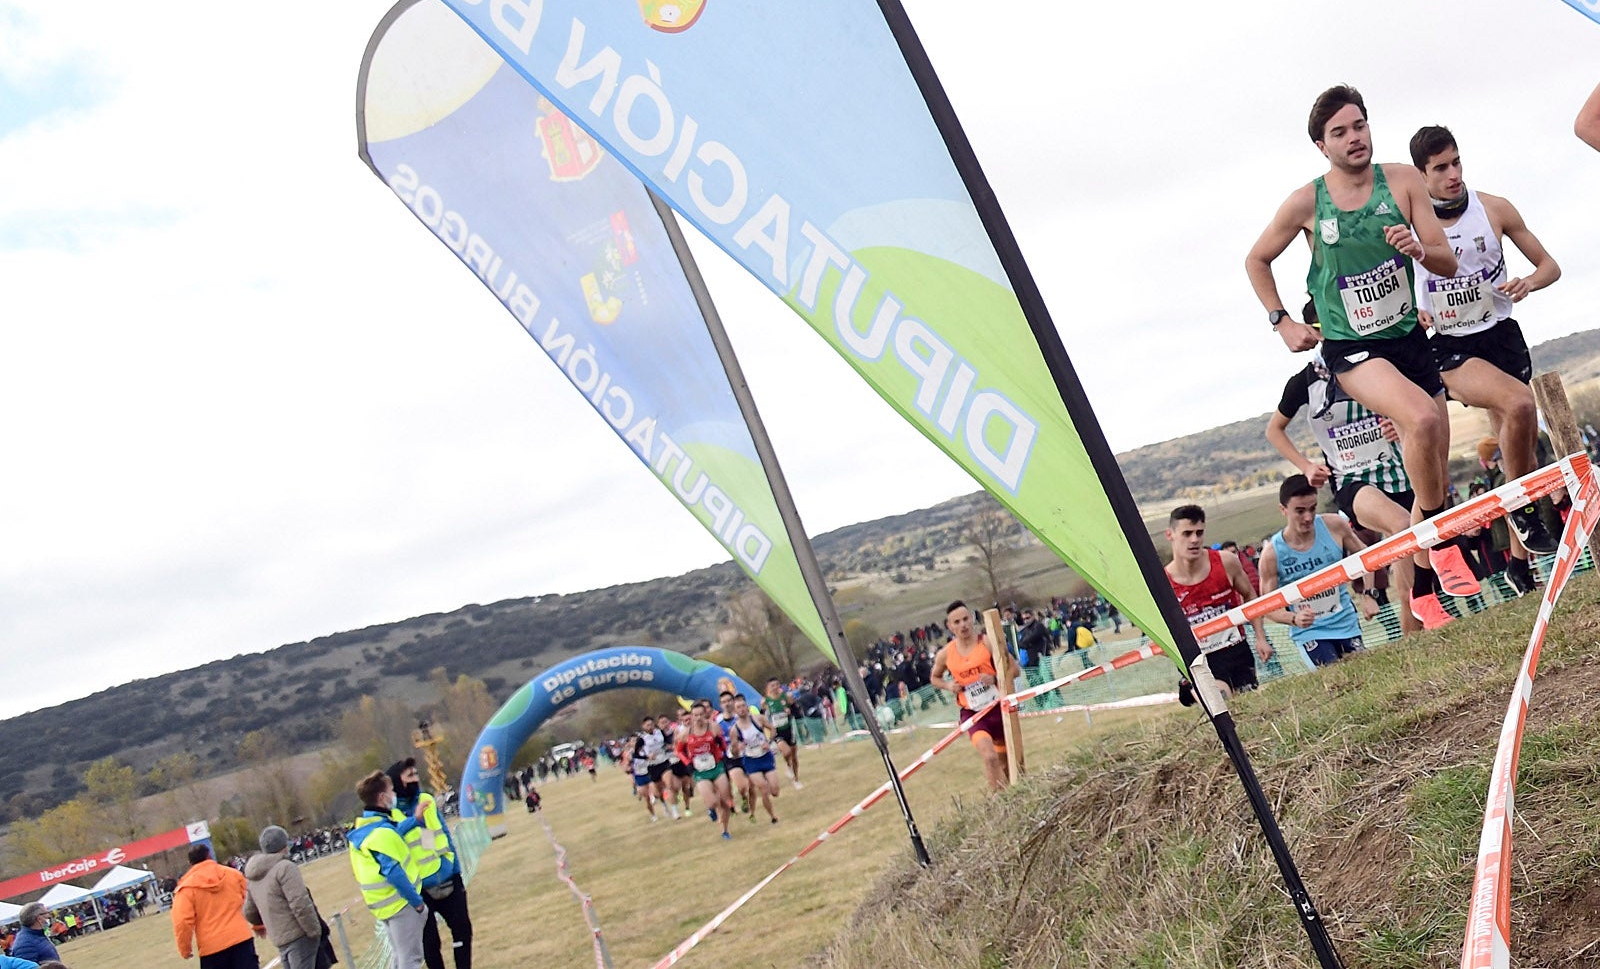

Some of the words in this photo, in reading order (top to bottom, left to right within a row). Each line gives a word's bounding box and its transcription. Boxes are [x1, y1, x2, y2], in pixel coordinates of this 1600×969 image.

[1345, 258, 1396, 282] DIPUTACIÓN
[1347, 265, 1398, 289] BURGOS
[1435, 271, 1483, 286] DIPUTACIÓN
[1354, 275, 1400, 304] TOLOSA
[1436, 276, 1485, 292] BURGOS
[1447, 287, 1482, 307] ORIVE
[1353, 306, 1374, 320] 165
[1439, 310, 1457, 320] 144
[1356, 315, 1395, 332] iberCaja
[1440, 319, 1476, 332] iberCaja
[1336, 428, 1383, 451] RODRIGUEZ
[1341, 452, 1355, 461] 155
[1285, 557, 1323, 575] nerja
[542, 652, 653, 693] Diputación
[551, 686, 576, 706] de
[579, 669, 655, 691] Burgos
[40, 858, 98, 882] iberCaja
